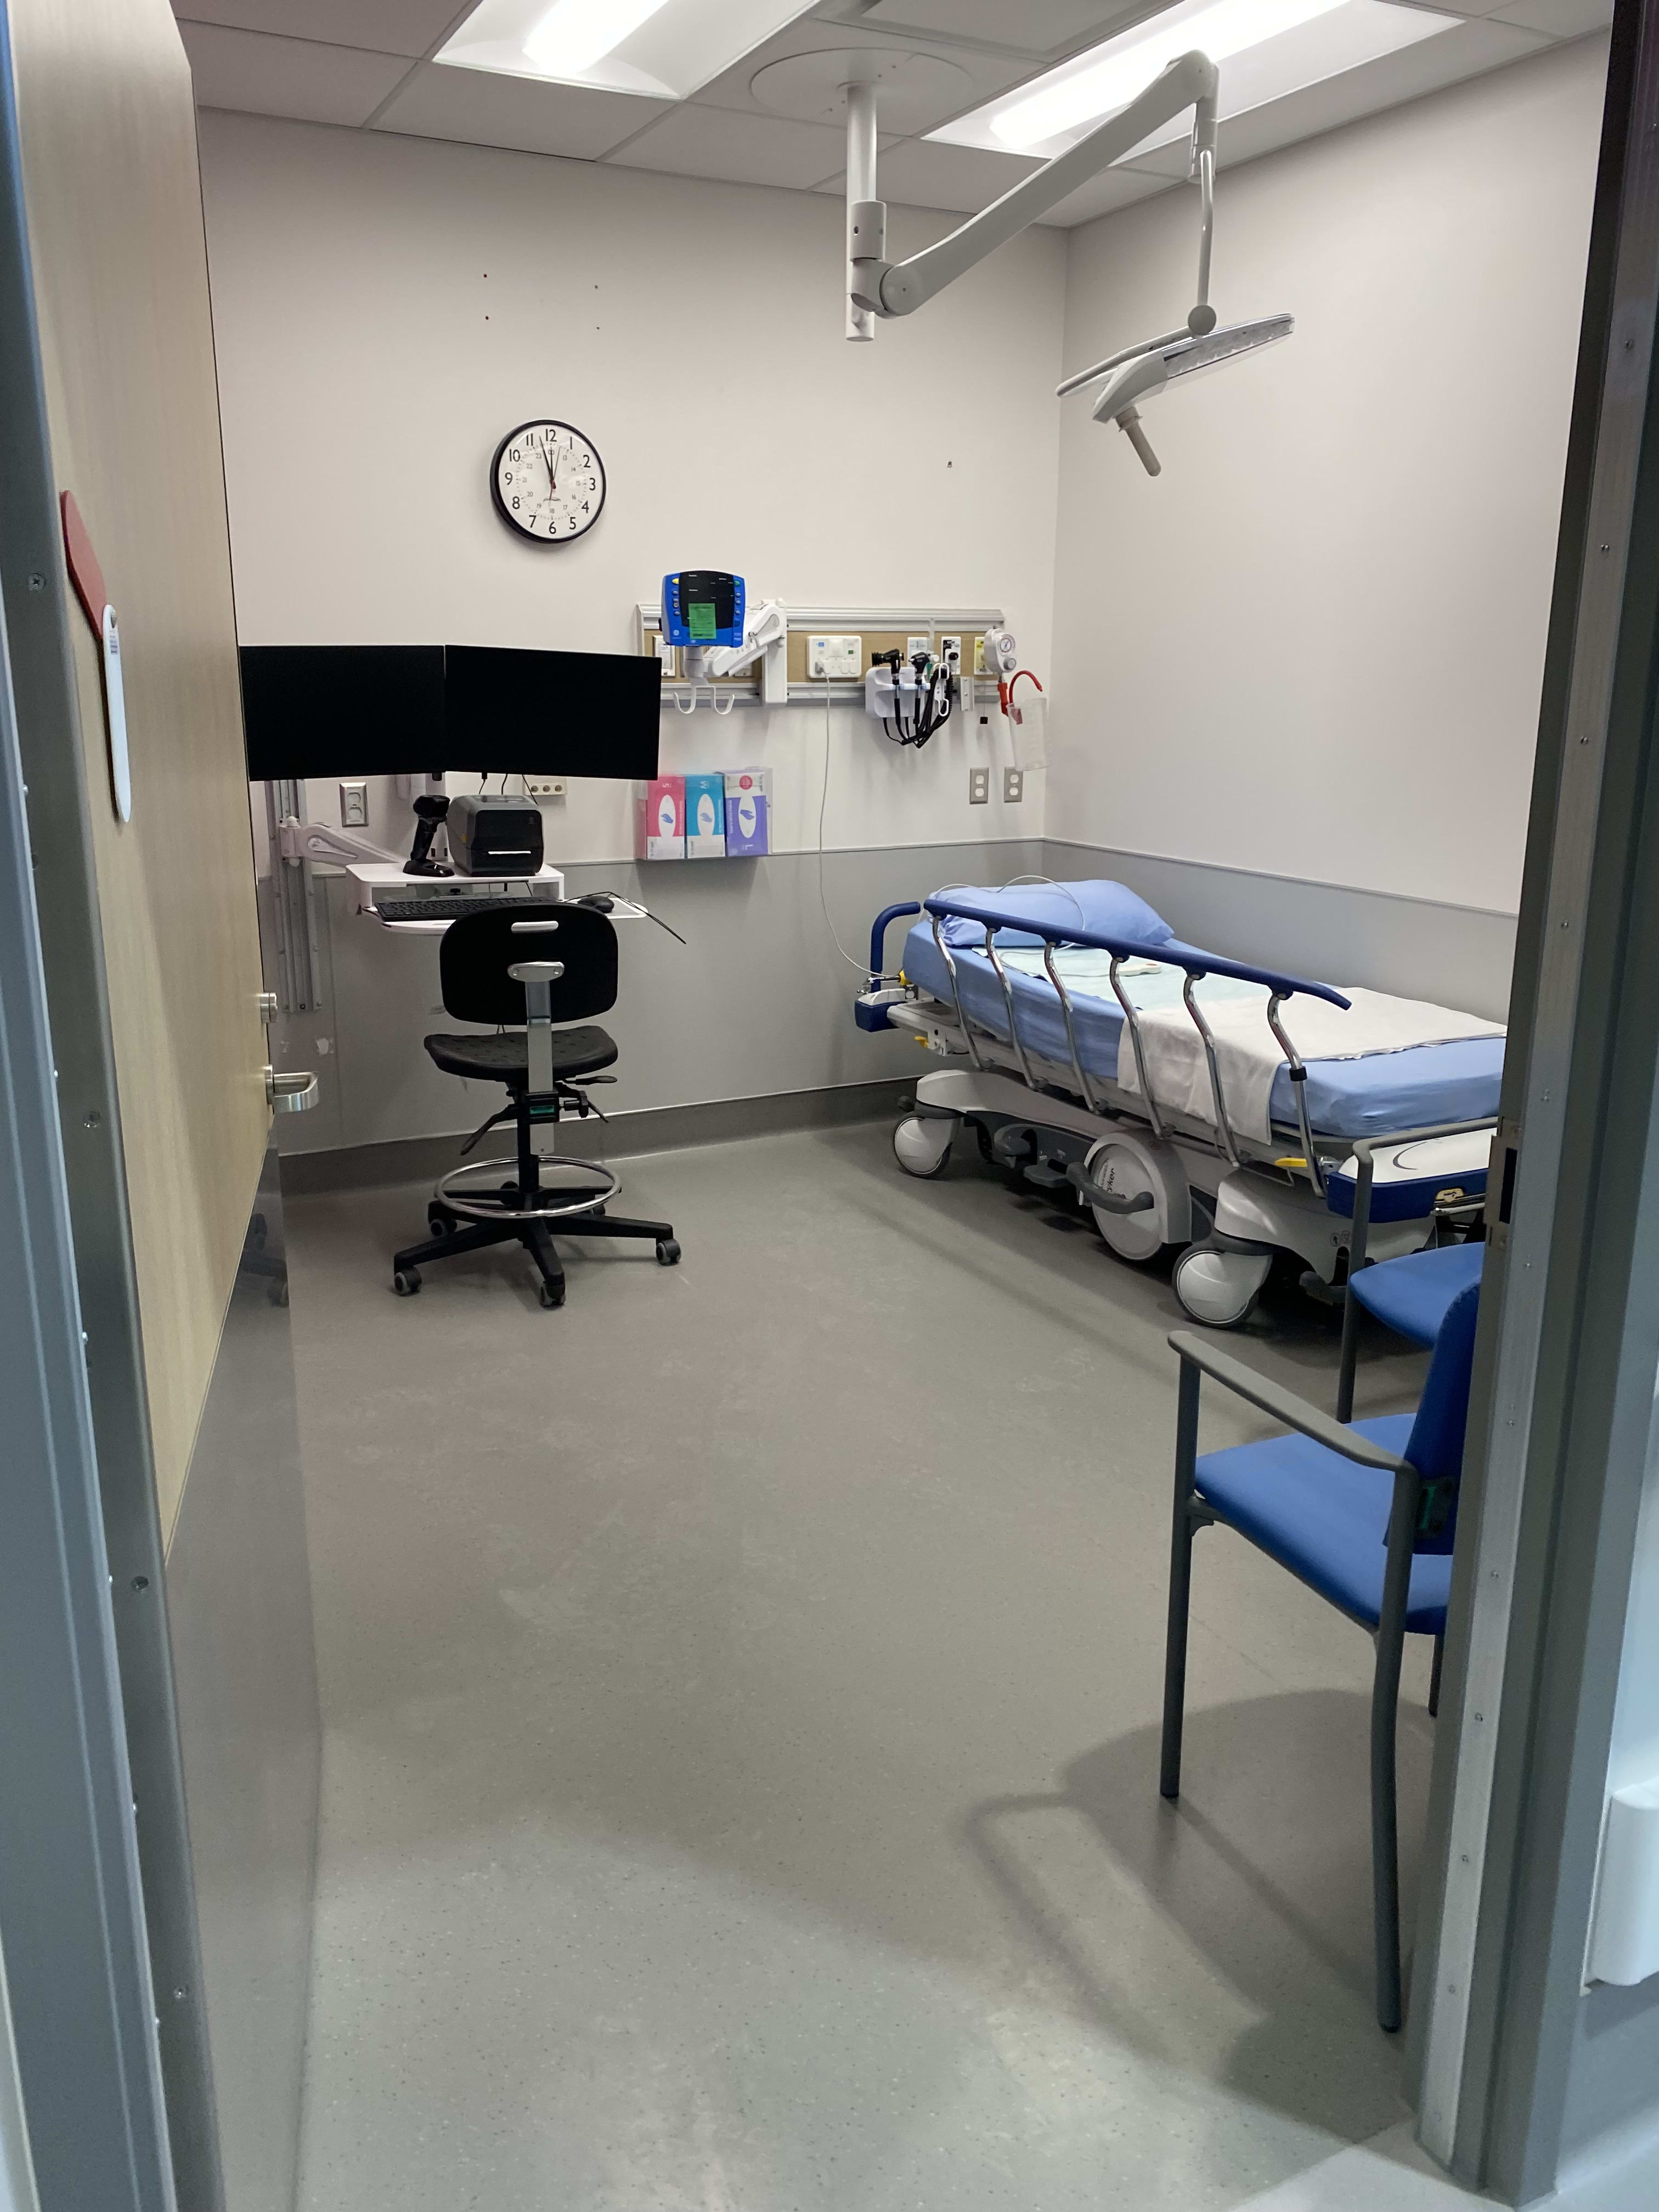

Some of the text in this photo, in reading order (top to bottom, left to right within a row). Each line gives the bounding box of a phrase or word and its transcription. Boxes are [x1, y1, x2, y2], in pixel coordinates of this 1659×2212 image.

[527, 433, 533, 446] 11
[546, 429, 557, 442] 12
[570, 436, 572, 450] 1
[509, 449, 520, 462] 10
[583, 454, 591, 468] 2
[505, 472, 513, 485] 9
[589, 477, 596, 490] 3
[512, 496, 520, 509] 8
[582, 500, 589, 514] 4
[529, 515, 537, 528] 7
[549, 521, 556, 534] 6
[569, 517, 576, 530] 5
[700, 781, 707, 789] M
